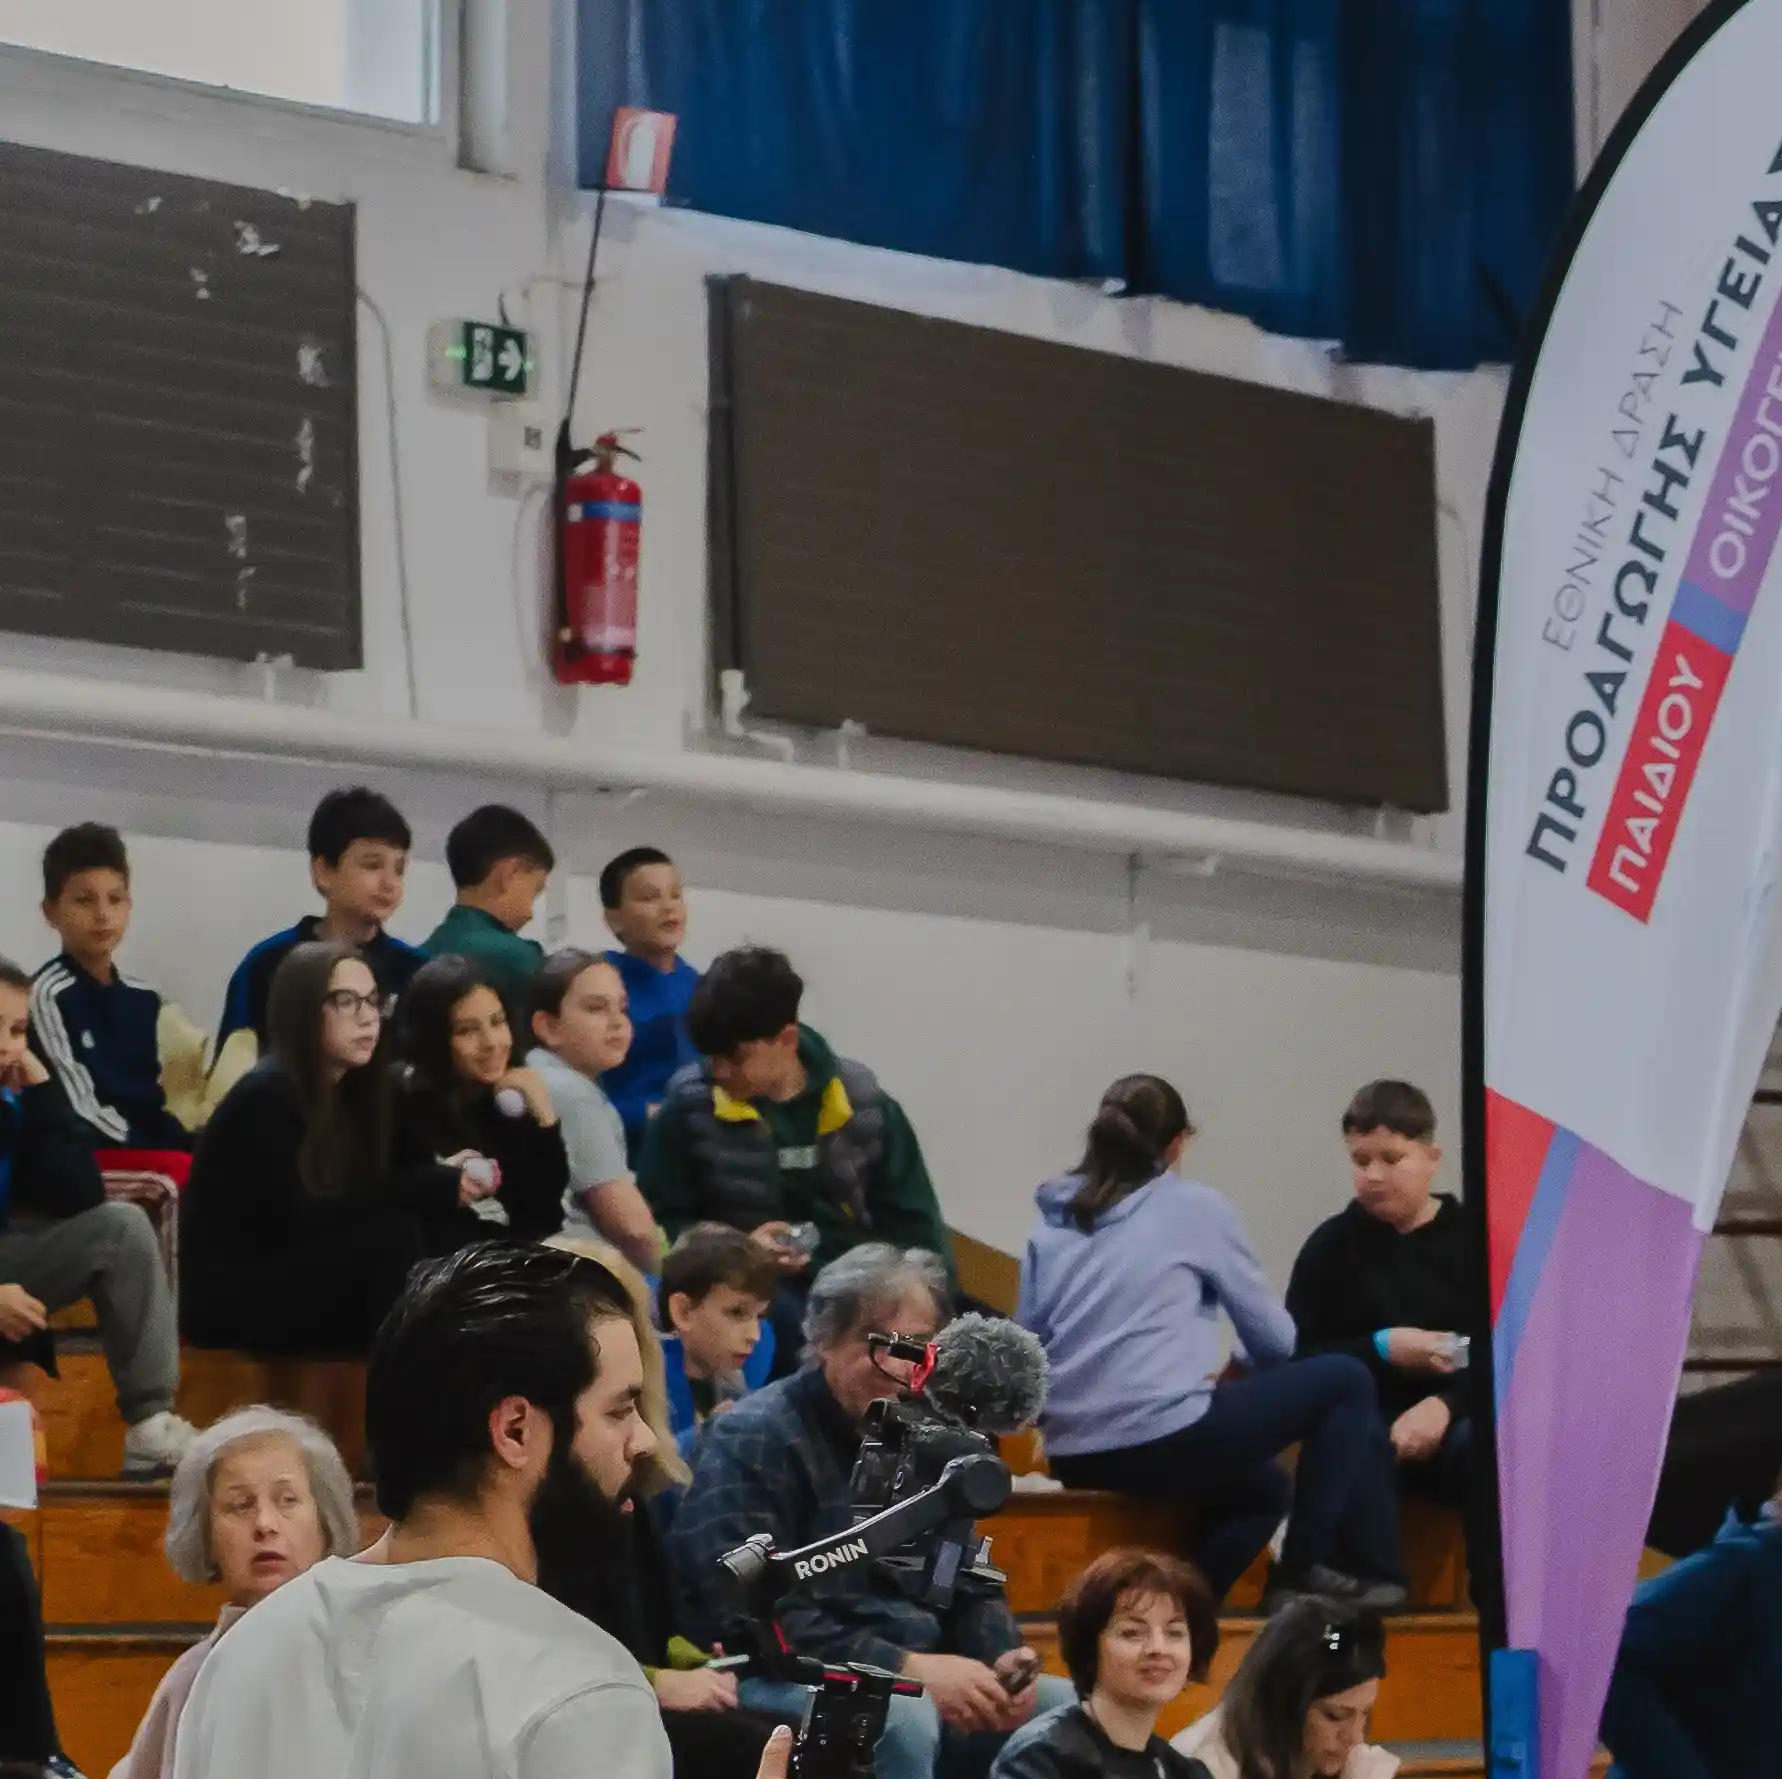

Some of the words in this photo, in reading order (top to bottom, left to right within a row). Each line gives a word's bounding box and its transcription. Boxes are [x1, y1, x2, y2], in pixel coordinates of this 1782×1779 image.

[1541, 466, 1625, 652] ΕΘΝΙΚΗ
[1611, 299, 1684, 459] ΔΡΑΣΗ
[1525, 411, 1708, 874] ΠΡΟΑΓΩΓΗΣ
[1607, 652, 1705, 895] ΠΑΙΔΙΟΥ
[794, 1538, 869, 1580] RONIN
